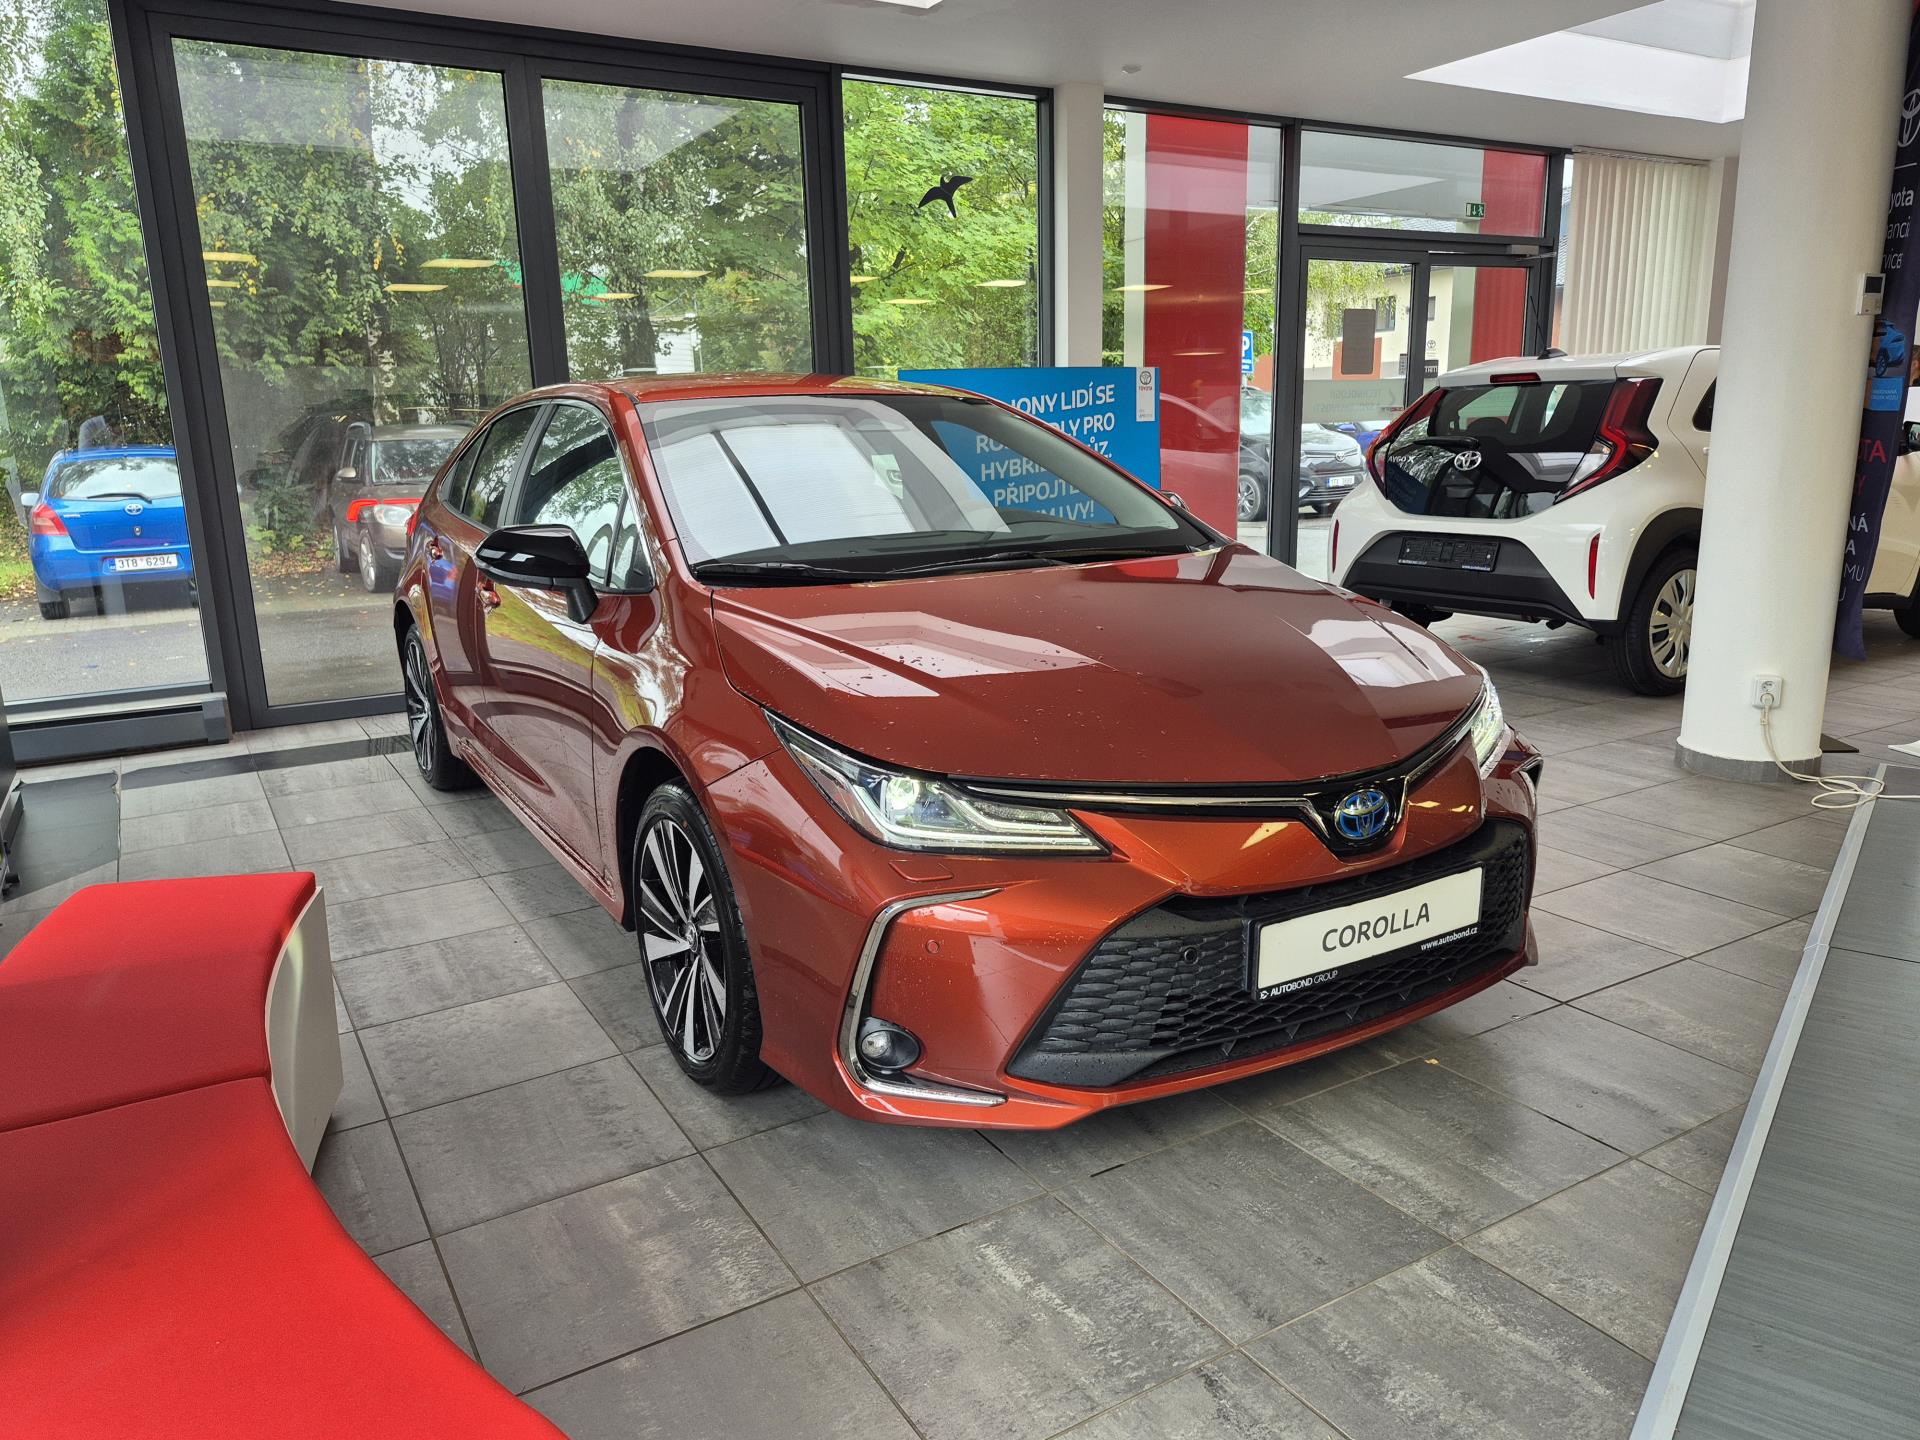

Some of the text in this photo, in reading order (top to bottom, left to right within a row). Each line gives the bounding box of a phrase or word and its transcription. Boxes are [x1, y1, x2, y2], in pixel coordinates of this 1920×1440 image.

[1061, 381, 1094, 411] LIDÍ
[1095, 384, 1115, 405] SE
[1083, 412, 1115, 435] PRO
[1065, 500, 1095, 521] VY!
[146, 556, 172, 567] 6294
[1322, 902, 1430, 952] COROLLA
[1420, 927, 1478, 951] www.autobond.cz
[1271, 970, 1338, 996] AUTOBOND GROUP
